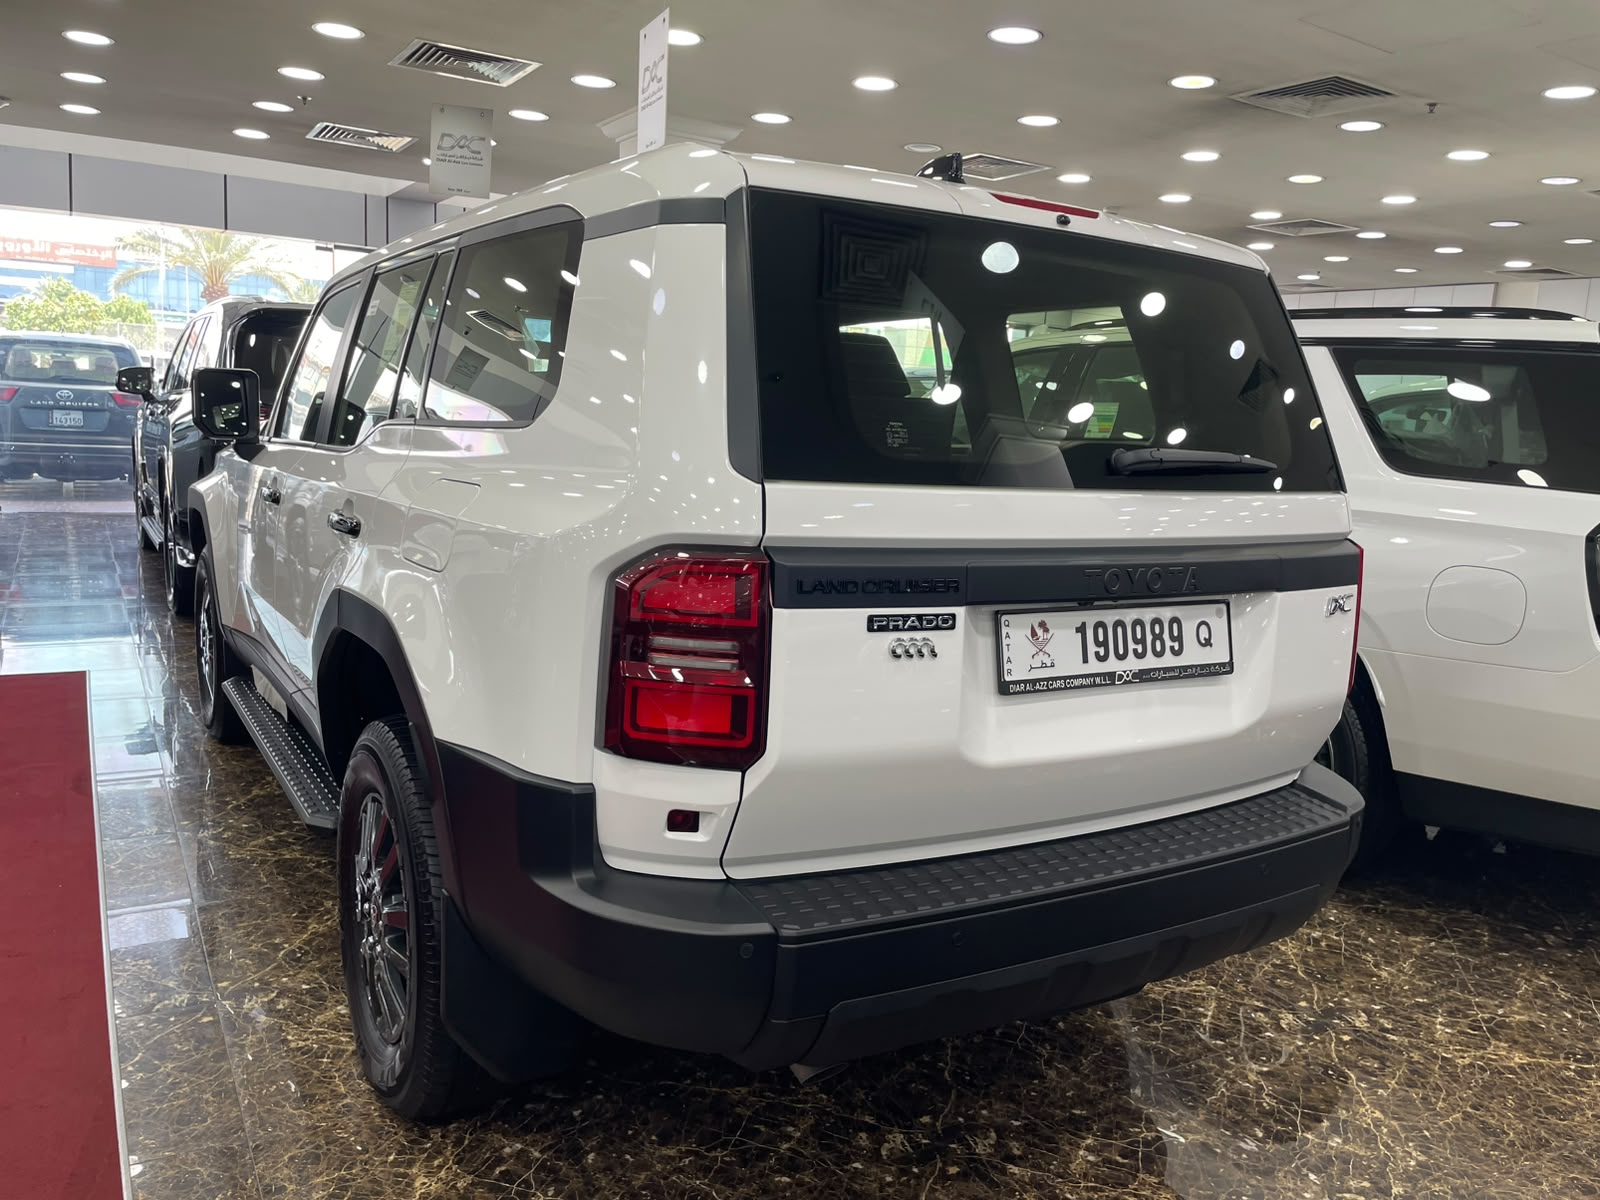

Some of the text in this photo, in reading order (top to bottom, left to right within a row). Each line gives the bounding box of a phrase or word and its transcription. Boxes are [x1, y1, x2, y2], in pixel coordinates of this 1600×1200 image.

[796, 578, 960, 595] LAND CRUISER
[1084, 566, 1200, 597] TOYOTA
[872, 615, 953, 630] PRADO
[1003, 619, 1013, 677] QATAR
[1075, 616, 1213, 664] 190989 Q
[1028, 659, 1055, 672] قطر
[1210, 663, 1231, 673] شركة
[1009, 682, 1025, 693] DIAR
[1026, 680, 1048, 691] AL-AZZ
[1048, 679, 1065, 689] CARS
[1065, 676, 1095, 688] COMPANY
